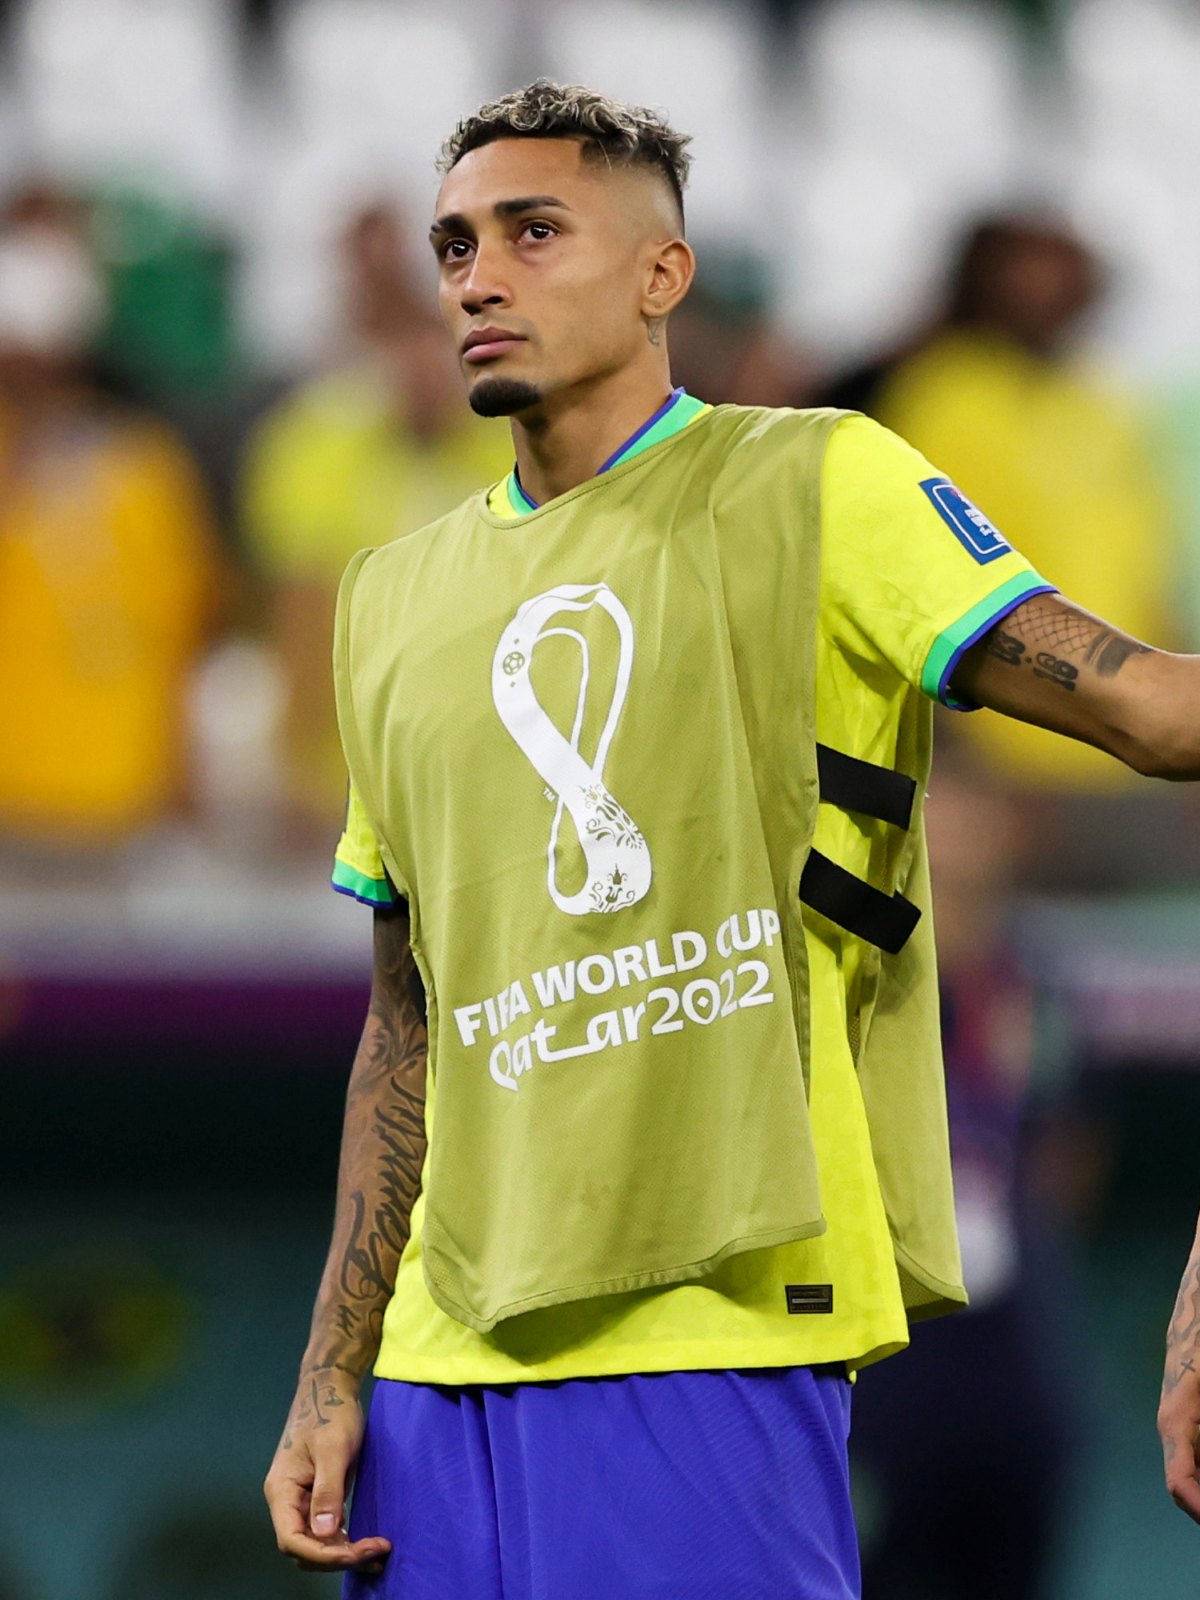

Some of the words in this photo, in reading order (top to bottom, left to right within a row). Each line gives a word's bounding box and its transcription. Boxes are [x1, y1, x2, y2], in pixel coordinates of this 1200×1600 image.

[453, 980, 532, 1047] FIFA
[531, 930, 708, 1008] WORLD
[715, 908, 782, 959] CUP
